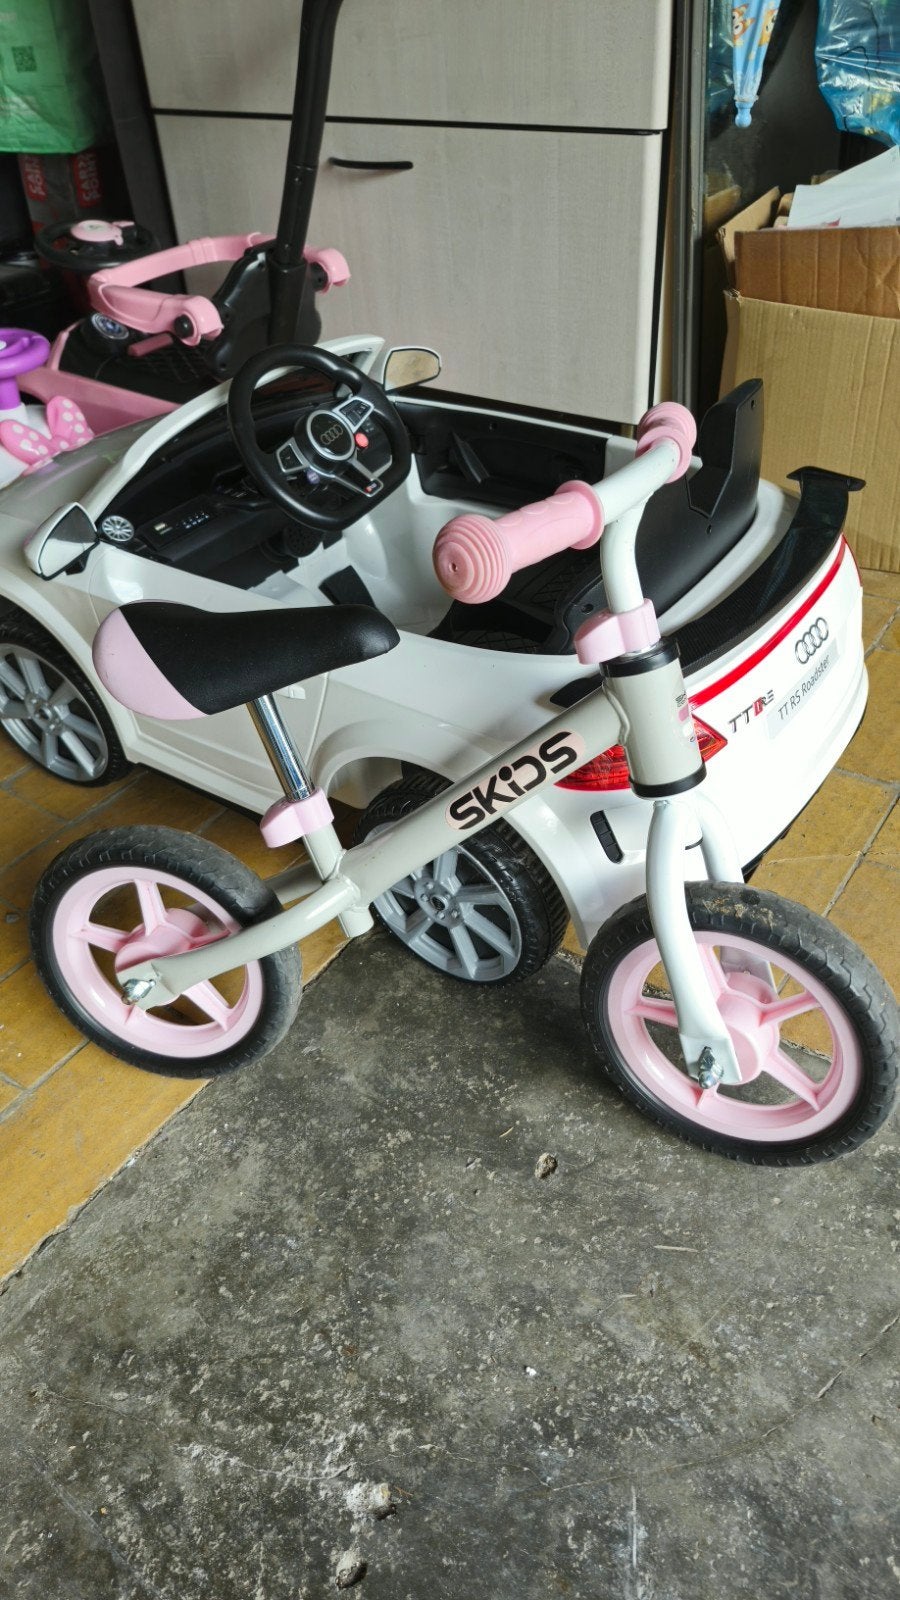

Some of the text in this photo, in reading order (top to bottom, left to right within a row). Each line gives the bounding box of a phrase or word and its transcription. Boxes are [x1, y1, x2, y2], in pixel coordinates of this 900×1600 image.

[777, 654, 830, 720] TT RS Roadster
